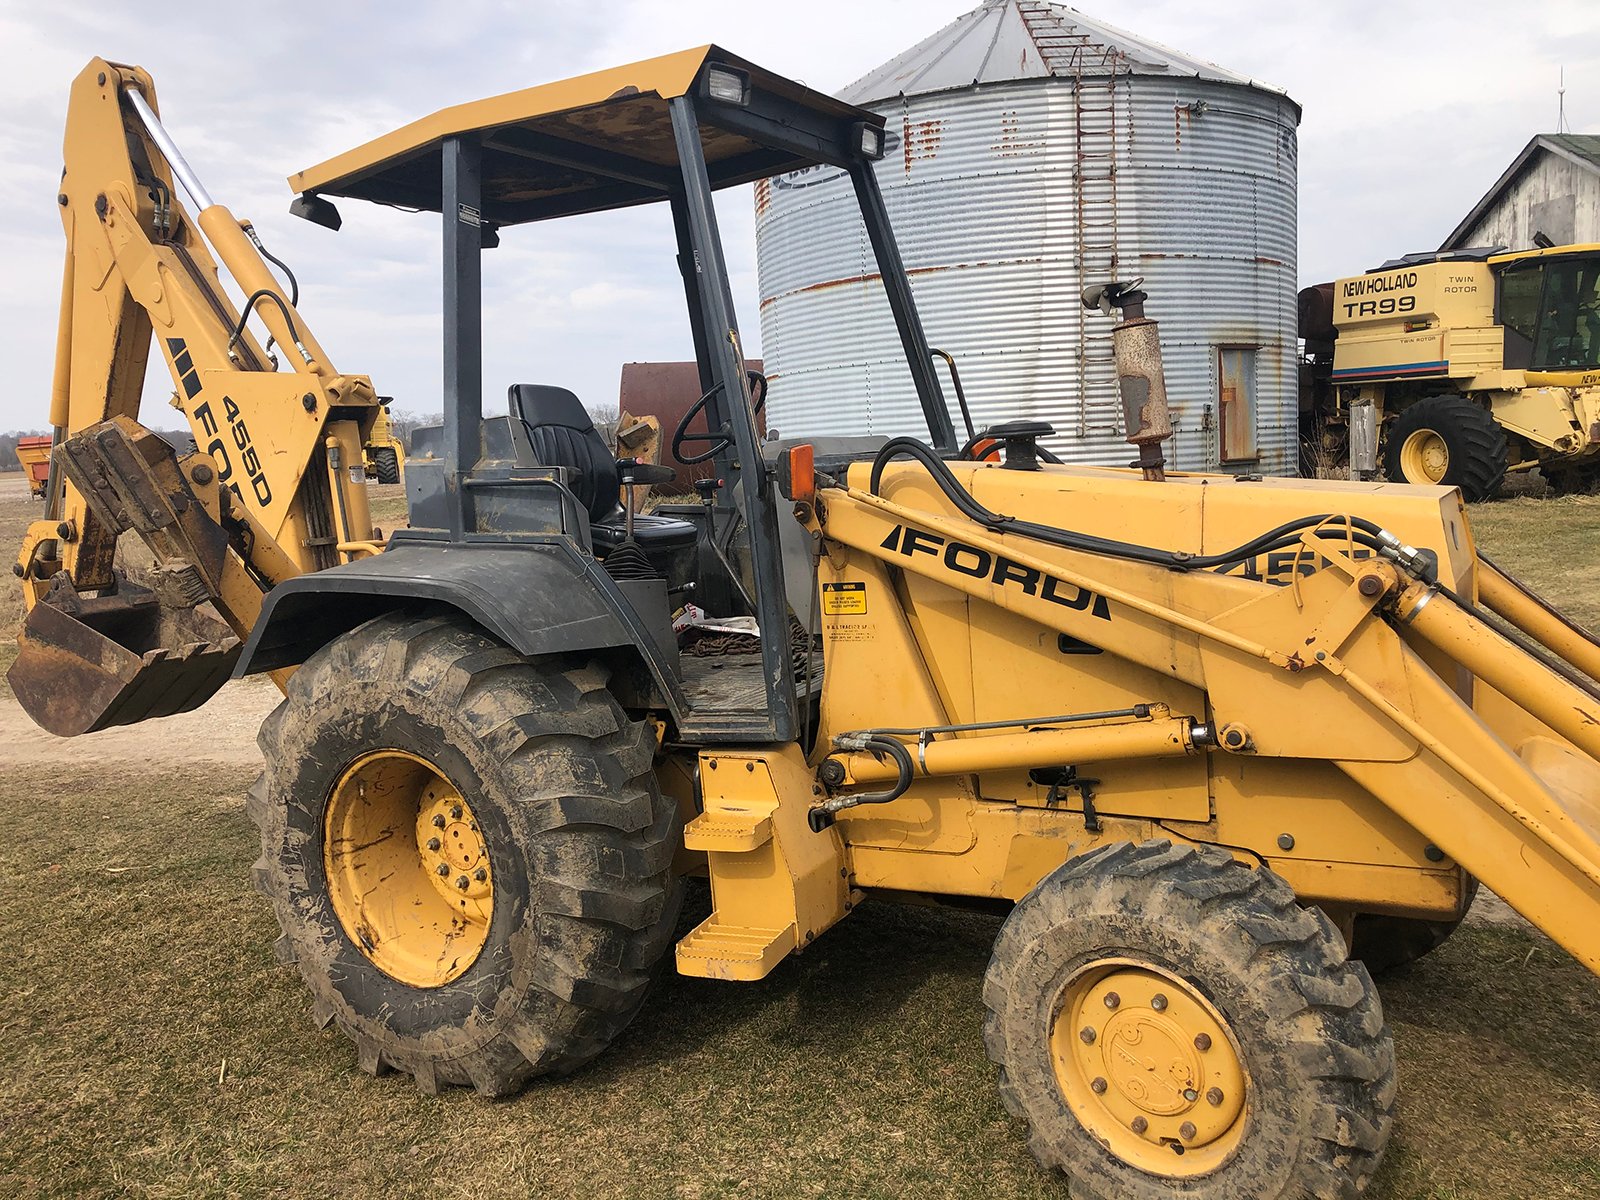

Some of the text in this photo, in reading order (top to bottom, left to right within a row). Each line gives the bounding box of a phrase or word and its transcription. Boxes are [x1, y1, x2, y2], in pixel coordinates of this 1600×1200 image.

[1343, 272, 1418, 298] NEW HOLLAND
[1343, 295, 1417, 318] TR99
[1581, 375, 1597, 385] NEW
[222, 395, 273, 508] 455D
[900, 526, 1096, 612] FORD
